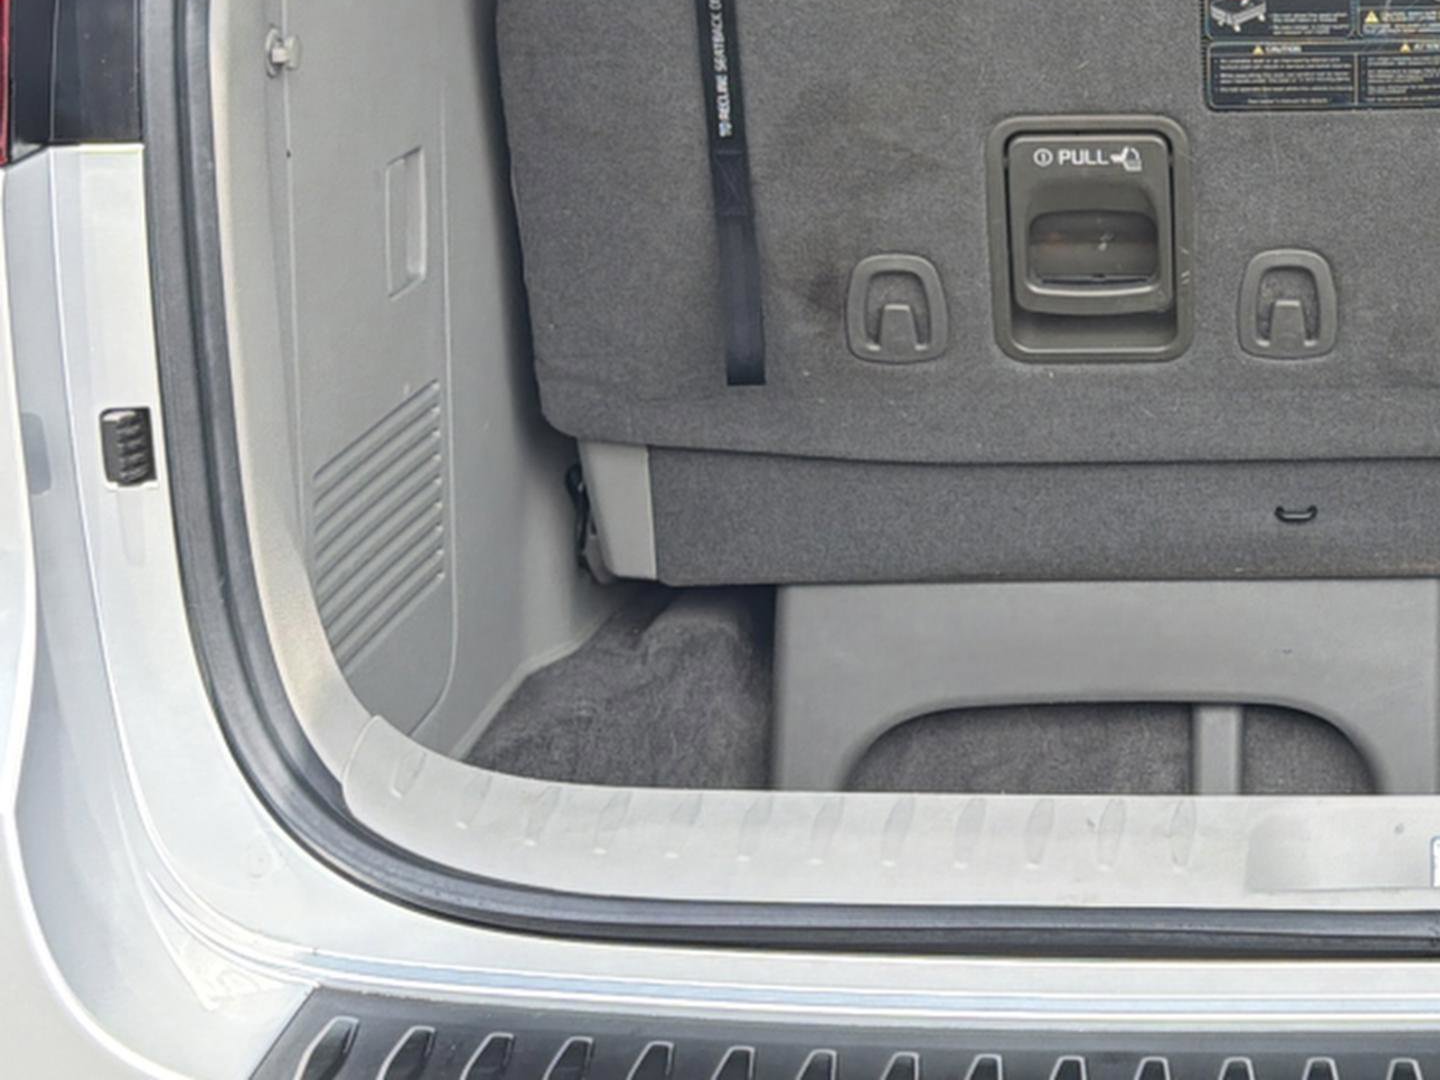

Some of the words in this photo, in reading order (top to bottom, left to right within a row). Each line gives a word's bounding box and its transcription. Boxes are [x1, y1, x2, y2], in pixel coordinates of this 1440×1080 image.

[711, 12, 728, 72] SEATBACK
[716, 74, 731, 121] RECLINE
[718, 121, 732, 137] TO
[1058, 148, 1109, 166] PULL
